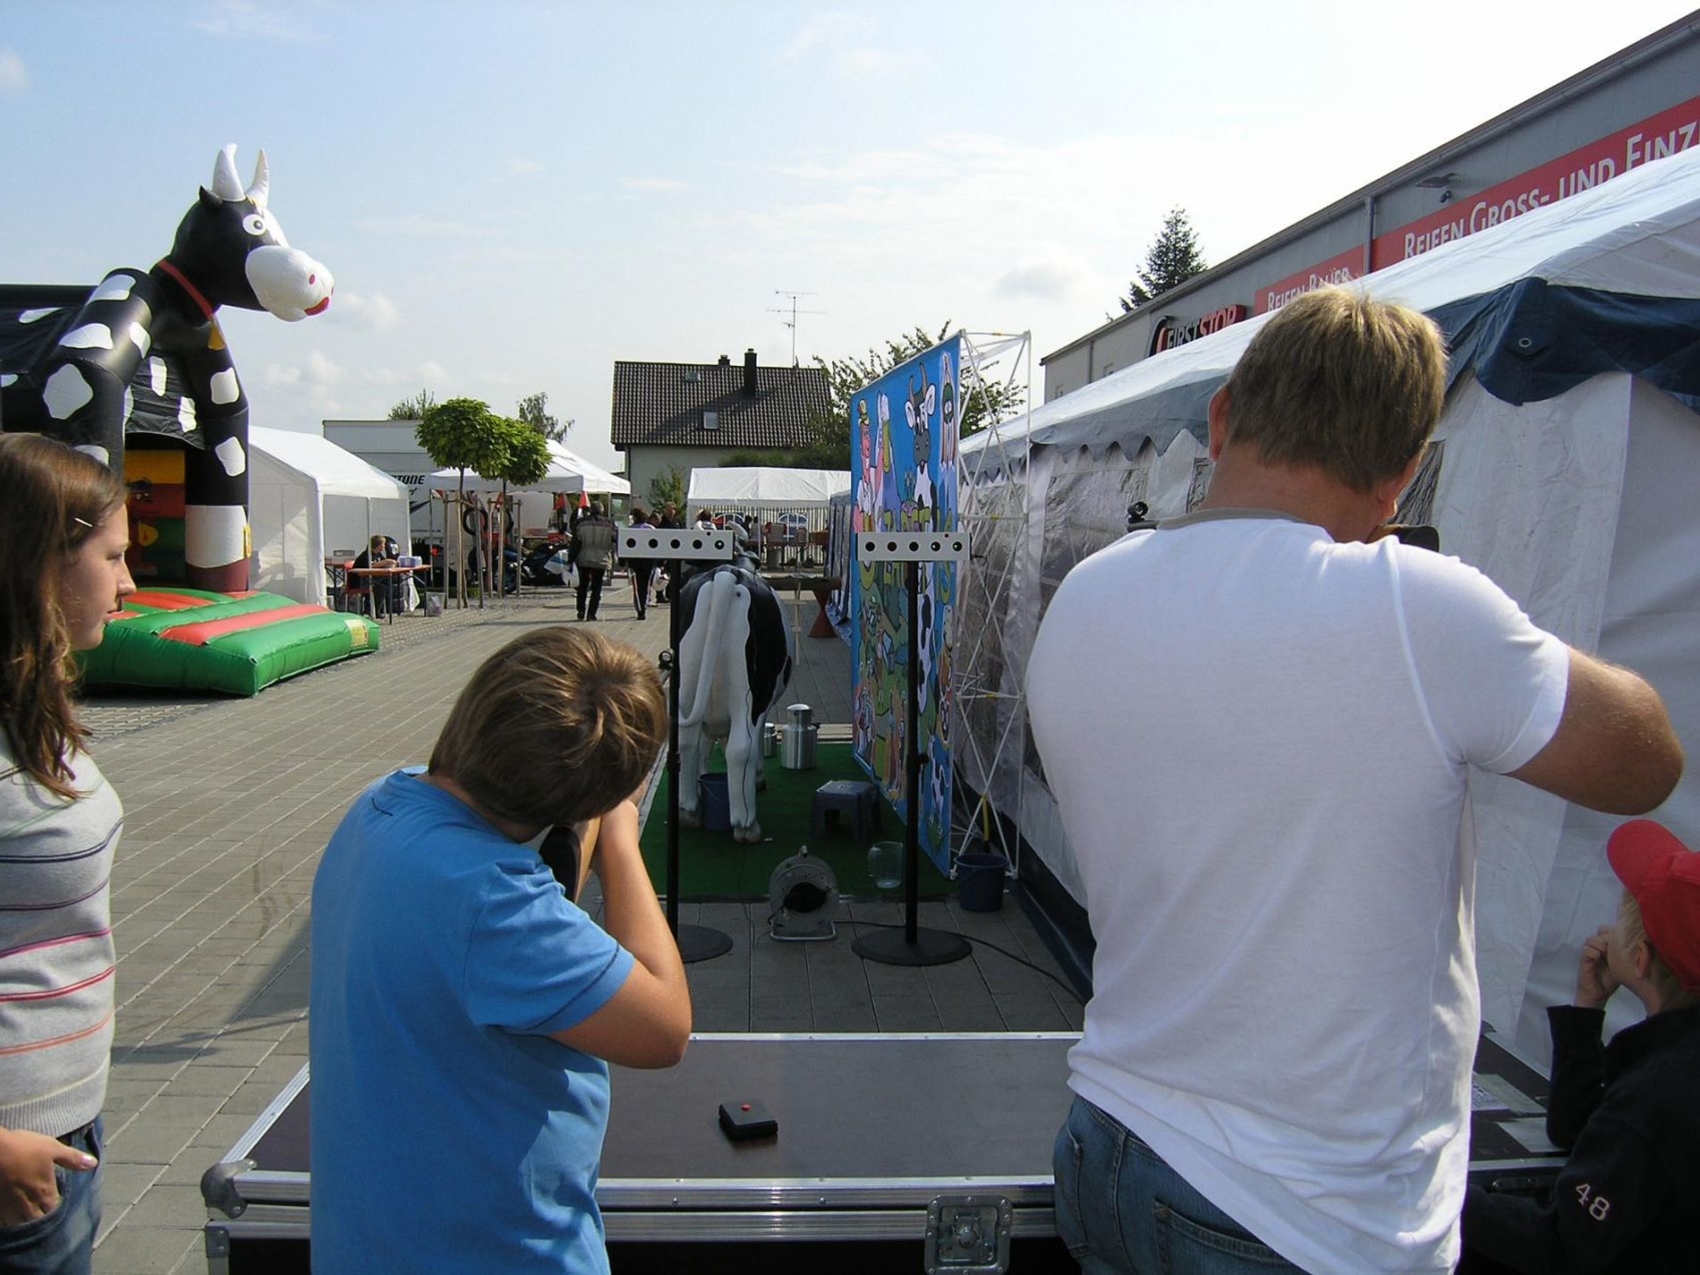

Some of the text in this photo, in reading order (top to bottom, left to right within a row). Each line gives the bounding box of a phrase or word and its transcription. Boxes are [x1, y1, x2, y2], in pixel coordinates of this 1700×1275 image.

[1405, 120, 1700, 259] REIFEN GROSS- UND EINZ
[1310, 266, 1352, 292] BUER
[1575, 1183, 1611, 1221] 48
